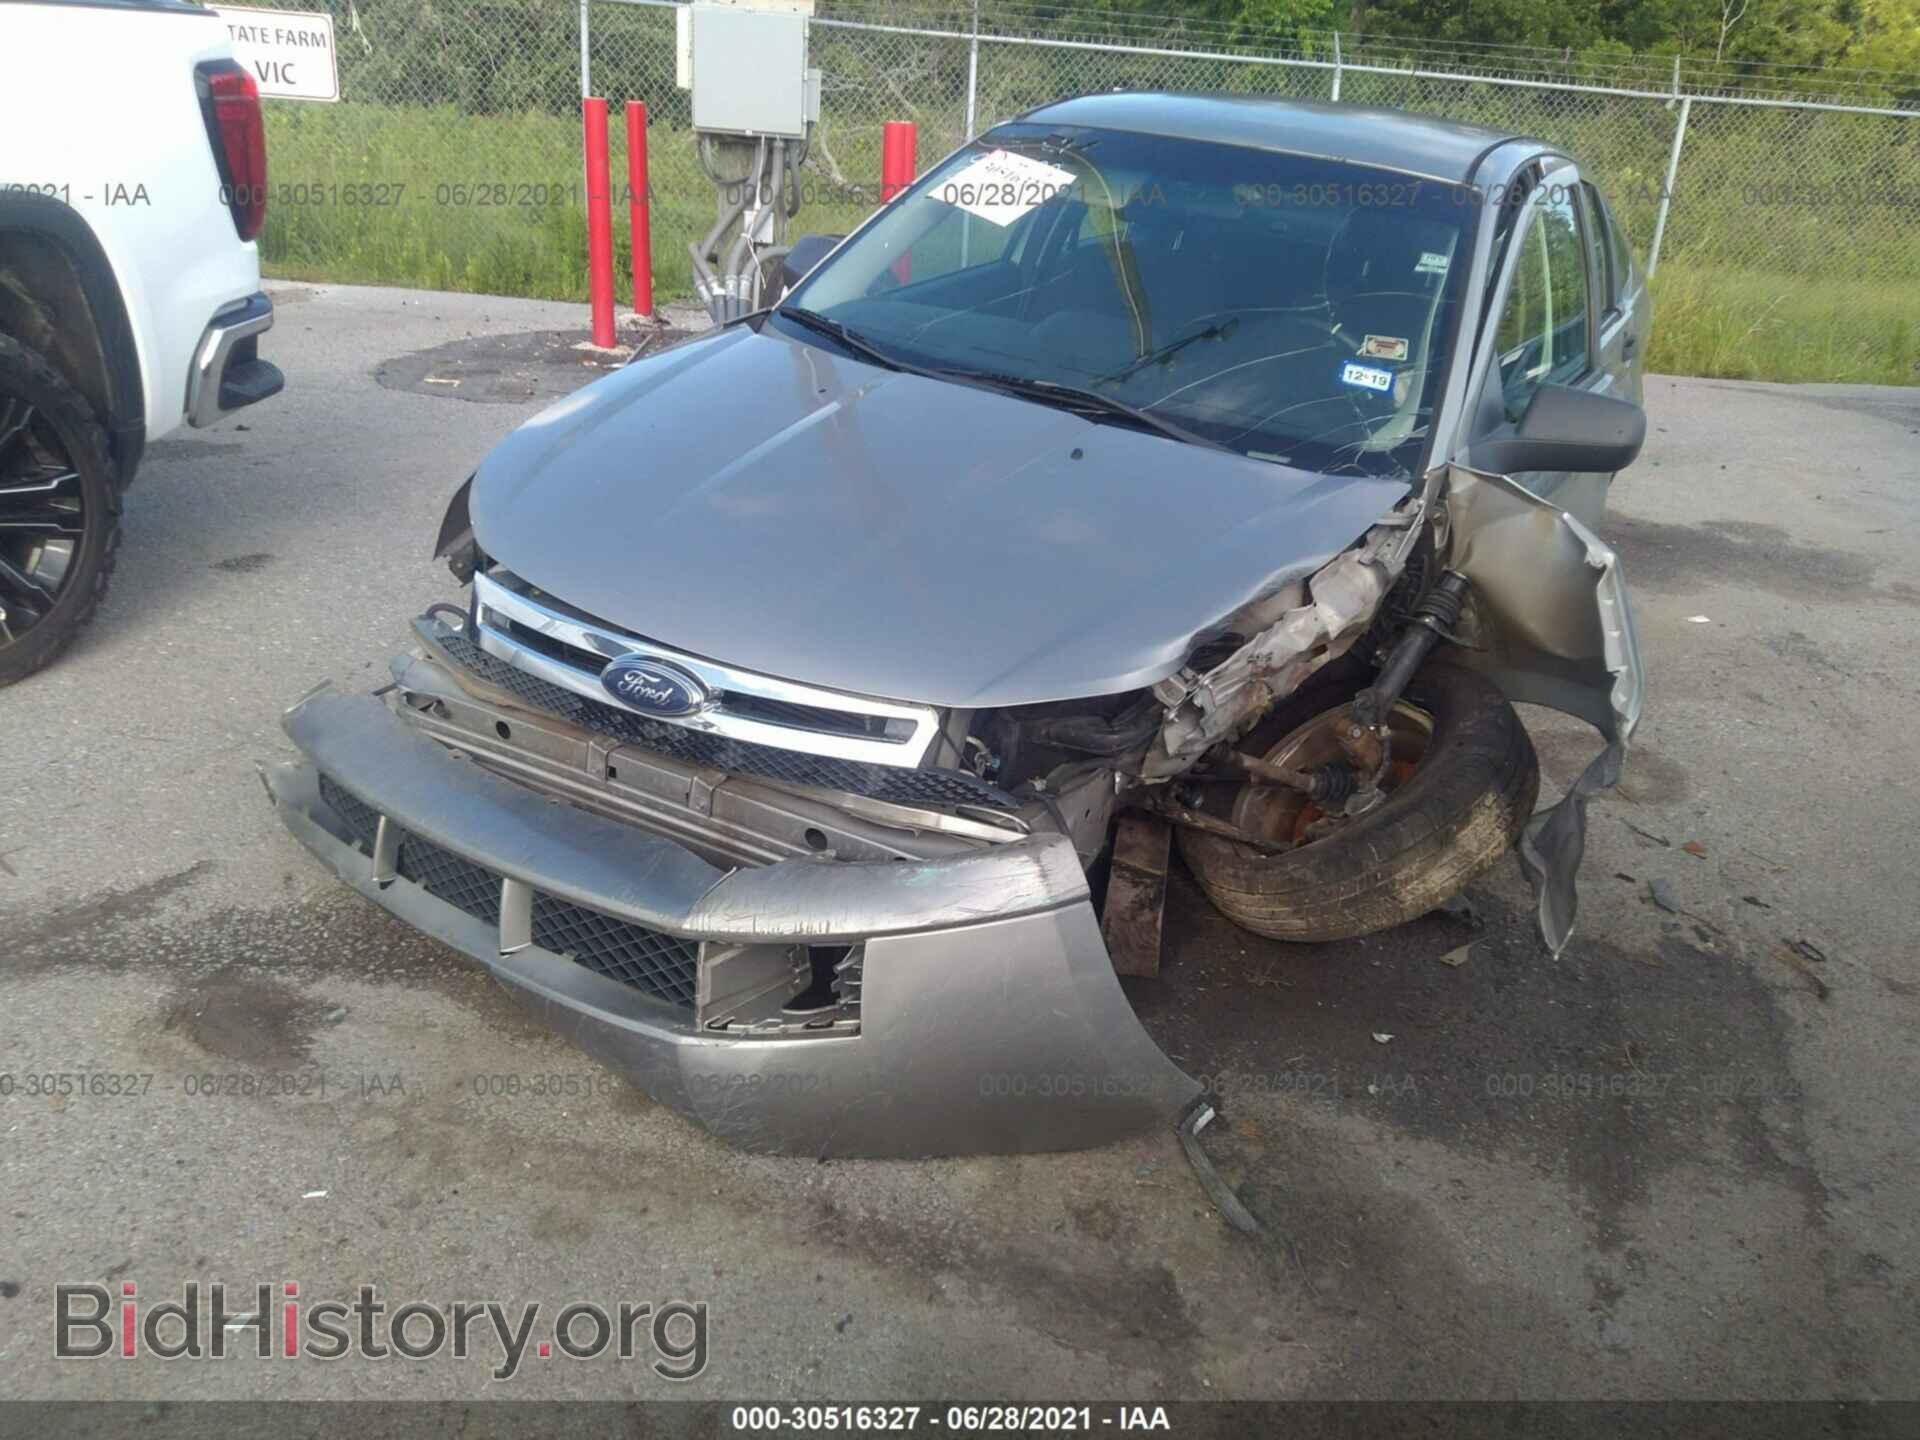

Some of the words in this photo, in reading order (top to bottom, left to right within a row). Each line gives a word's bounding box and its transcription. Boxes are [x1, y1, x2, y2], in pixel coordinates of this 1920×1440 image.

[227, 24, 271, 44] TATE
[275, 28, 327, 48] FARM
[254, 60, 297, 84] VIC
[617, 669, 675, 705] Ford
